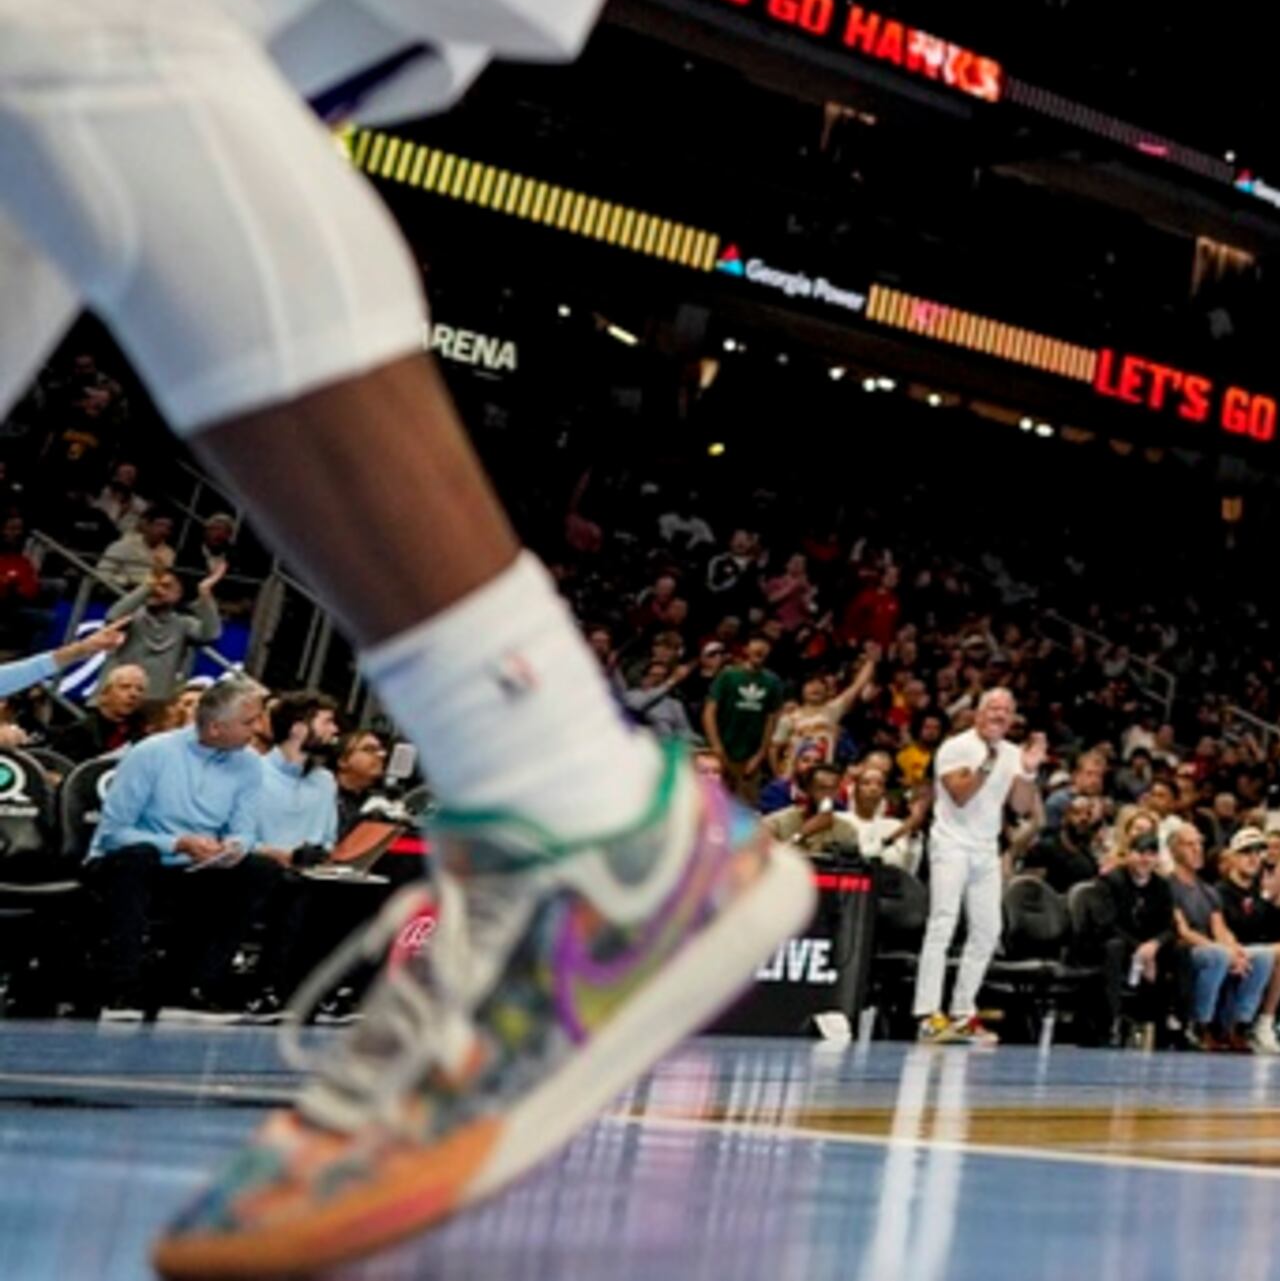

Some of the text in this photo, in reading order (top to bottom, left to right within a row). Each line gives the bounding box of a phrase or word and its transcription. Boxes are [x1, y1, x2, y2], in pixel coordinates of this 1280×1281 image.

[842, 4, 1003, 103] HAWKS
[1095, 348, 1213, 422] LET'S
[1222, 385, 1277, 442] GO
